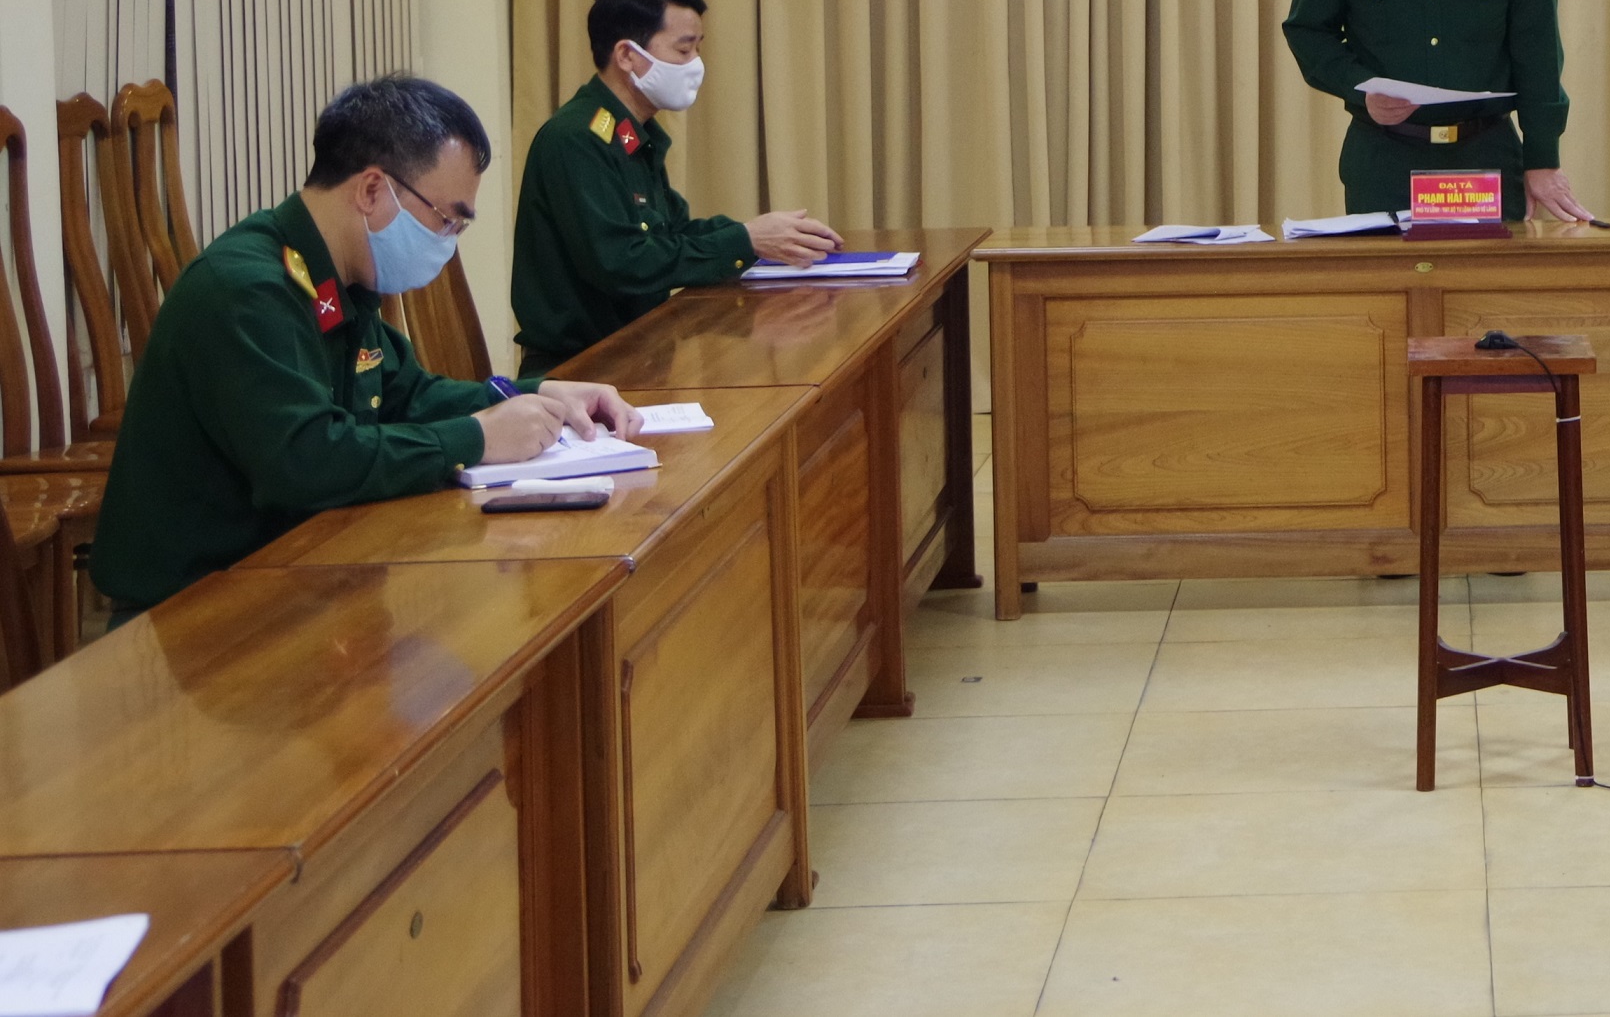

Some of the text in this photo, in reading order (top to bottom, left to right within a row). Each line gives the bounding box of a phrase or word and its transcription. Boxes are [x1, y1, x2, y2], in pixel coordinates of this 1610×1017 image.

[1439, 182, 1457, 190] ĐẠI
[1418, 189, 1495, 206] PHẠM HẢI TRUNG
